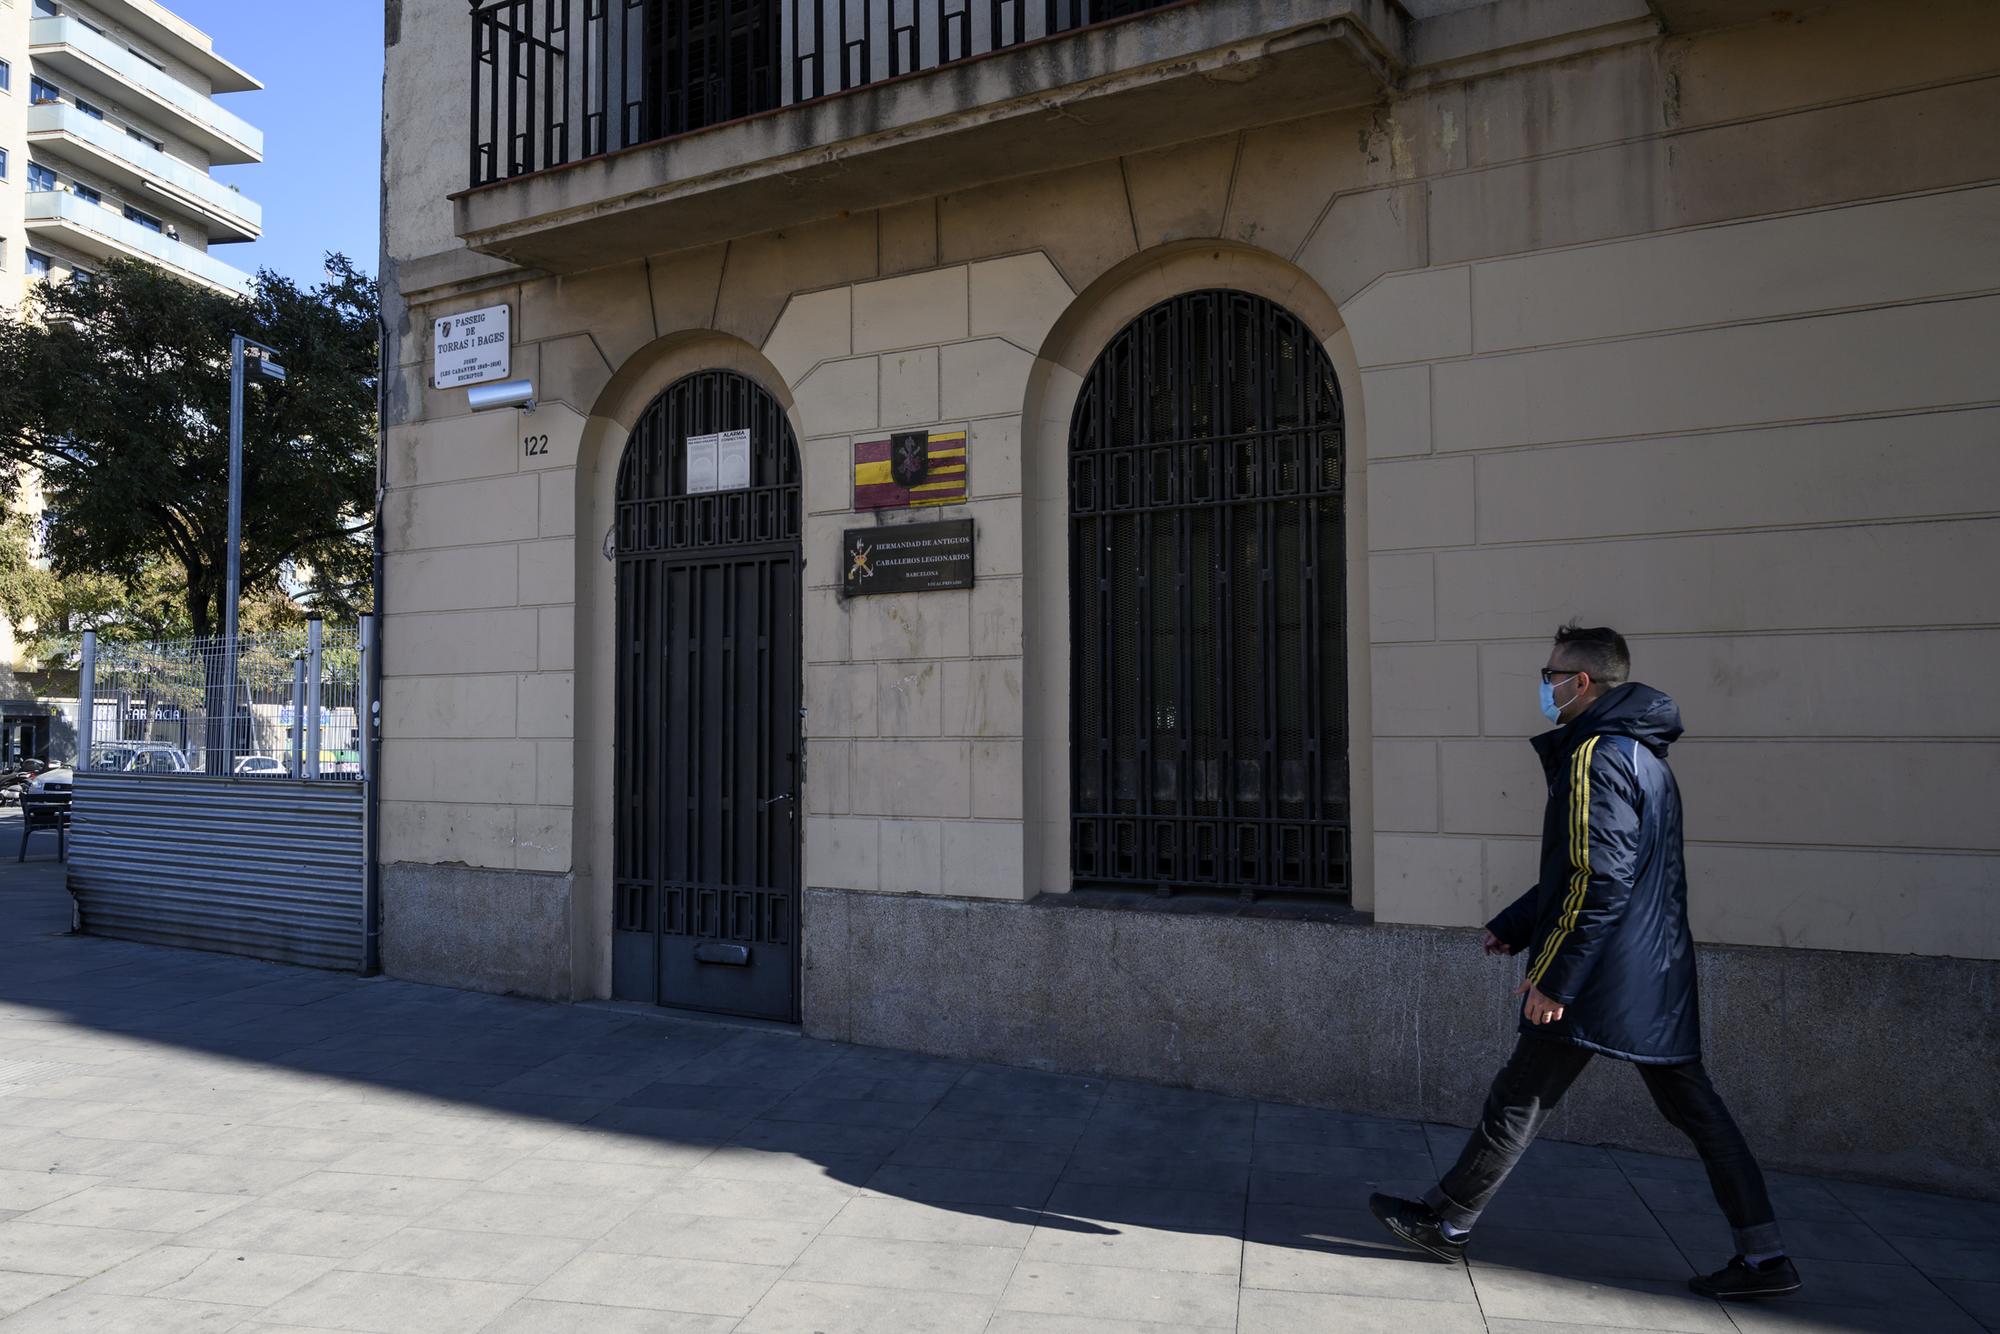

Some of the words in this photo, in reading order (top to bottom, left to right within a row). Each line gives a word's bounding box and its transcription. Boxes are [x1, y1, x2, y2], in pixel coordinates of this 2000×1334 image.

[455, 313, 486, 327] PASSEIG
[465, 326, 476, 337] DE
[438, 339, 469, 354] TORRAS
[471, 338, 475, 348] I
[477, 331, 505, 347] BAGES
[463, 357, 478, 366] JOSEP
[457, 371, 484, 382] ESCRIPTOR
[524, 434, 548, 457] 122
[876, 541, 921, 550] HERMANDAD
[922, 539, 932, 547] DE
[932, 536, 970, 546] ANTIGUOS
[875, 557, 920, 566] CABALLEROS
[921, 553, 970, 563] LEGIONARIOS
[127, 707, 180, 720] FARÀCIA
